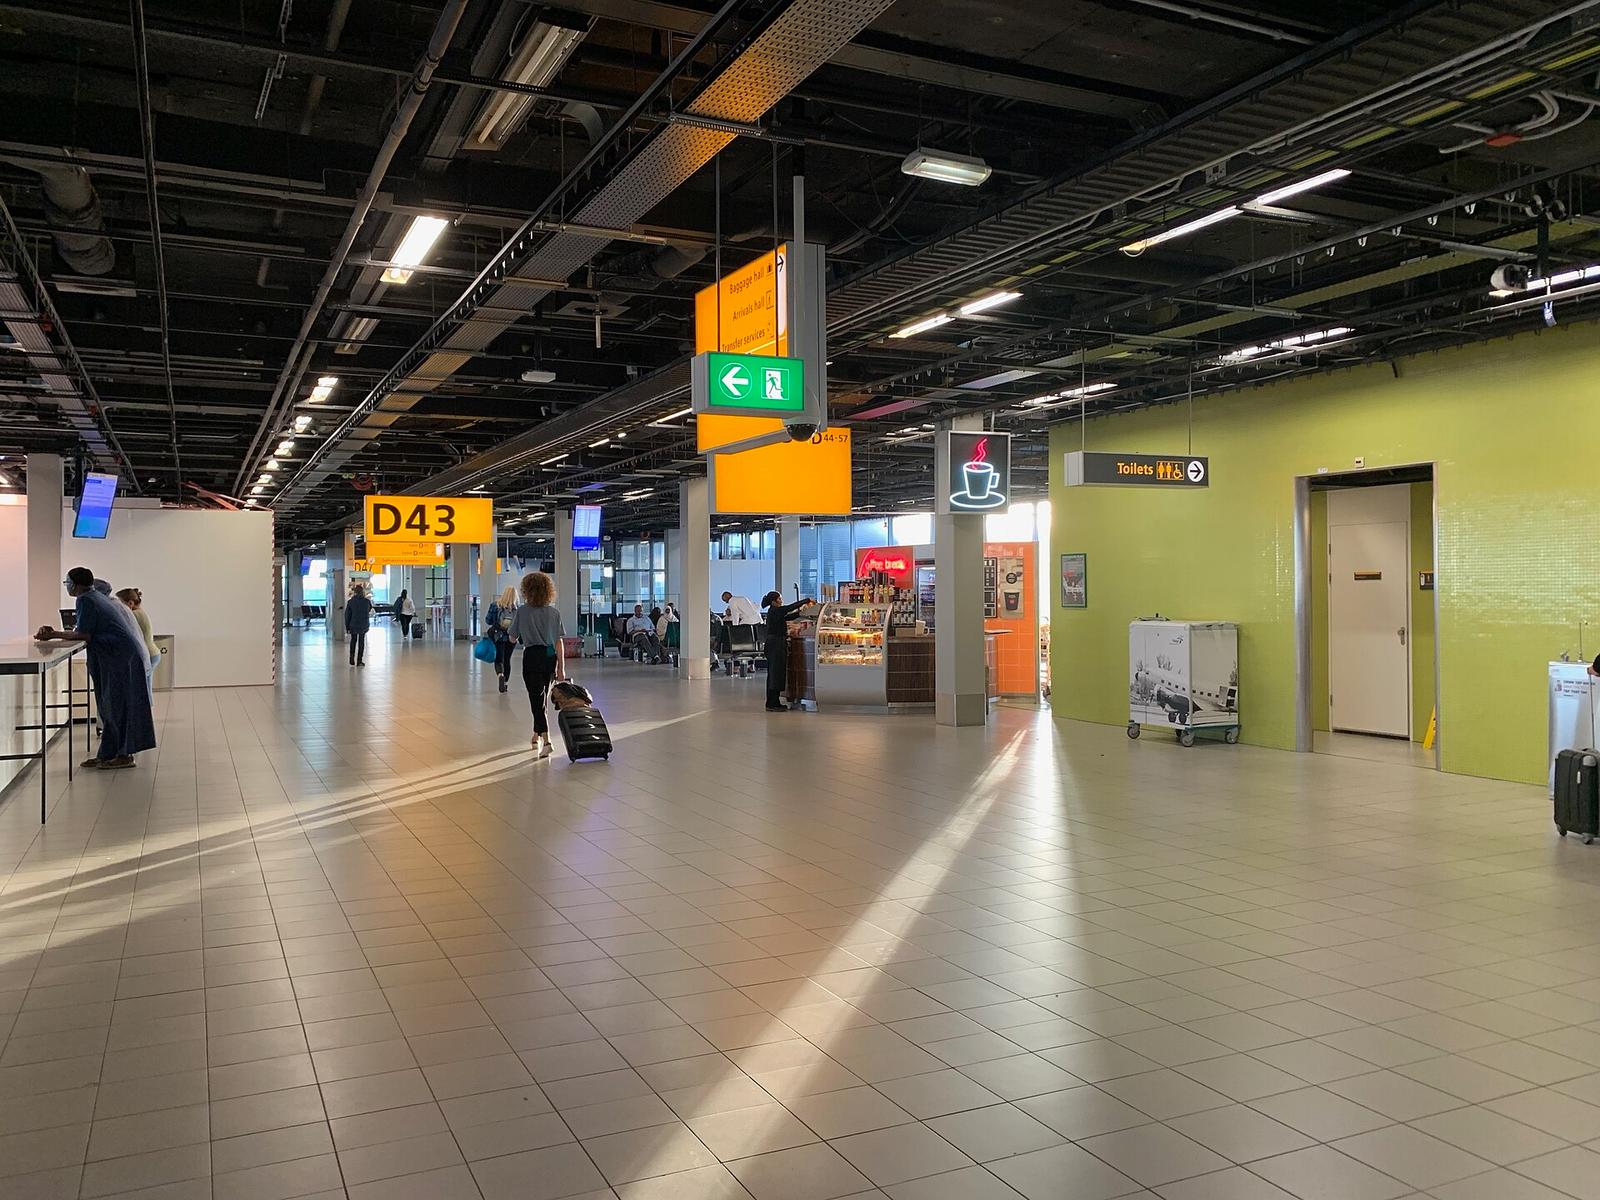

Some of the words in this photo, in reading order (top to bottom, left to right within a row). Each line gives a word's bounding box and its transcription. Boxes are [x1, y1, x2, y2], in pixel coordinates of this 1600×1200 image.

[729, 275, 753, 294] Baggage
[753, 267, 765, 281] hall
[732, 303, 753, 321] Arrivals
[754, 295, 765, 310] hall
[721, 336, 743, 352] Transfer
[743, 328, 765, 345] services
[1117, 462, 1154, 475] Toilets
[373, 503, 456, 536] D43
